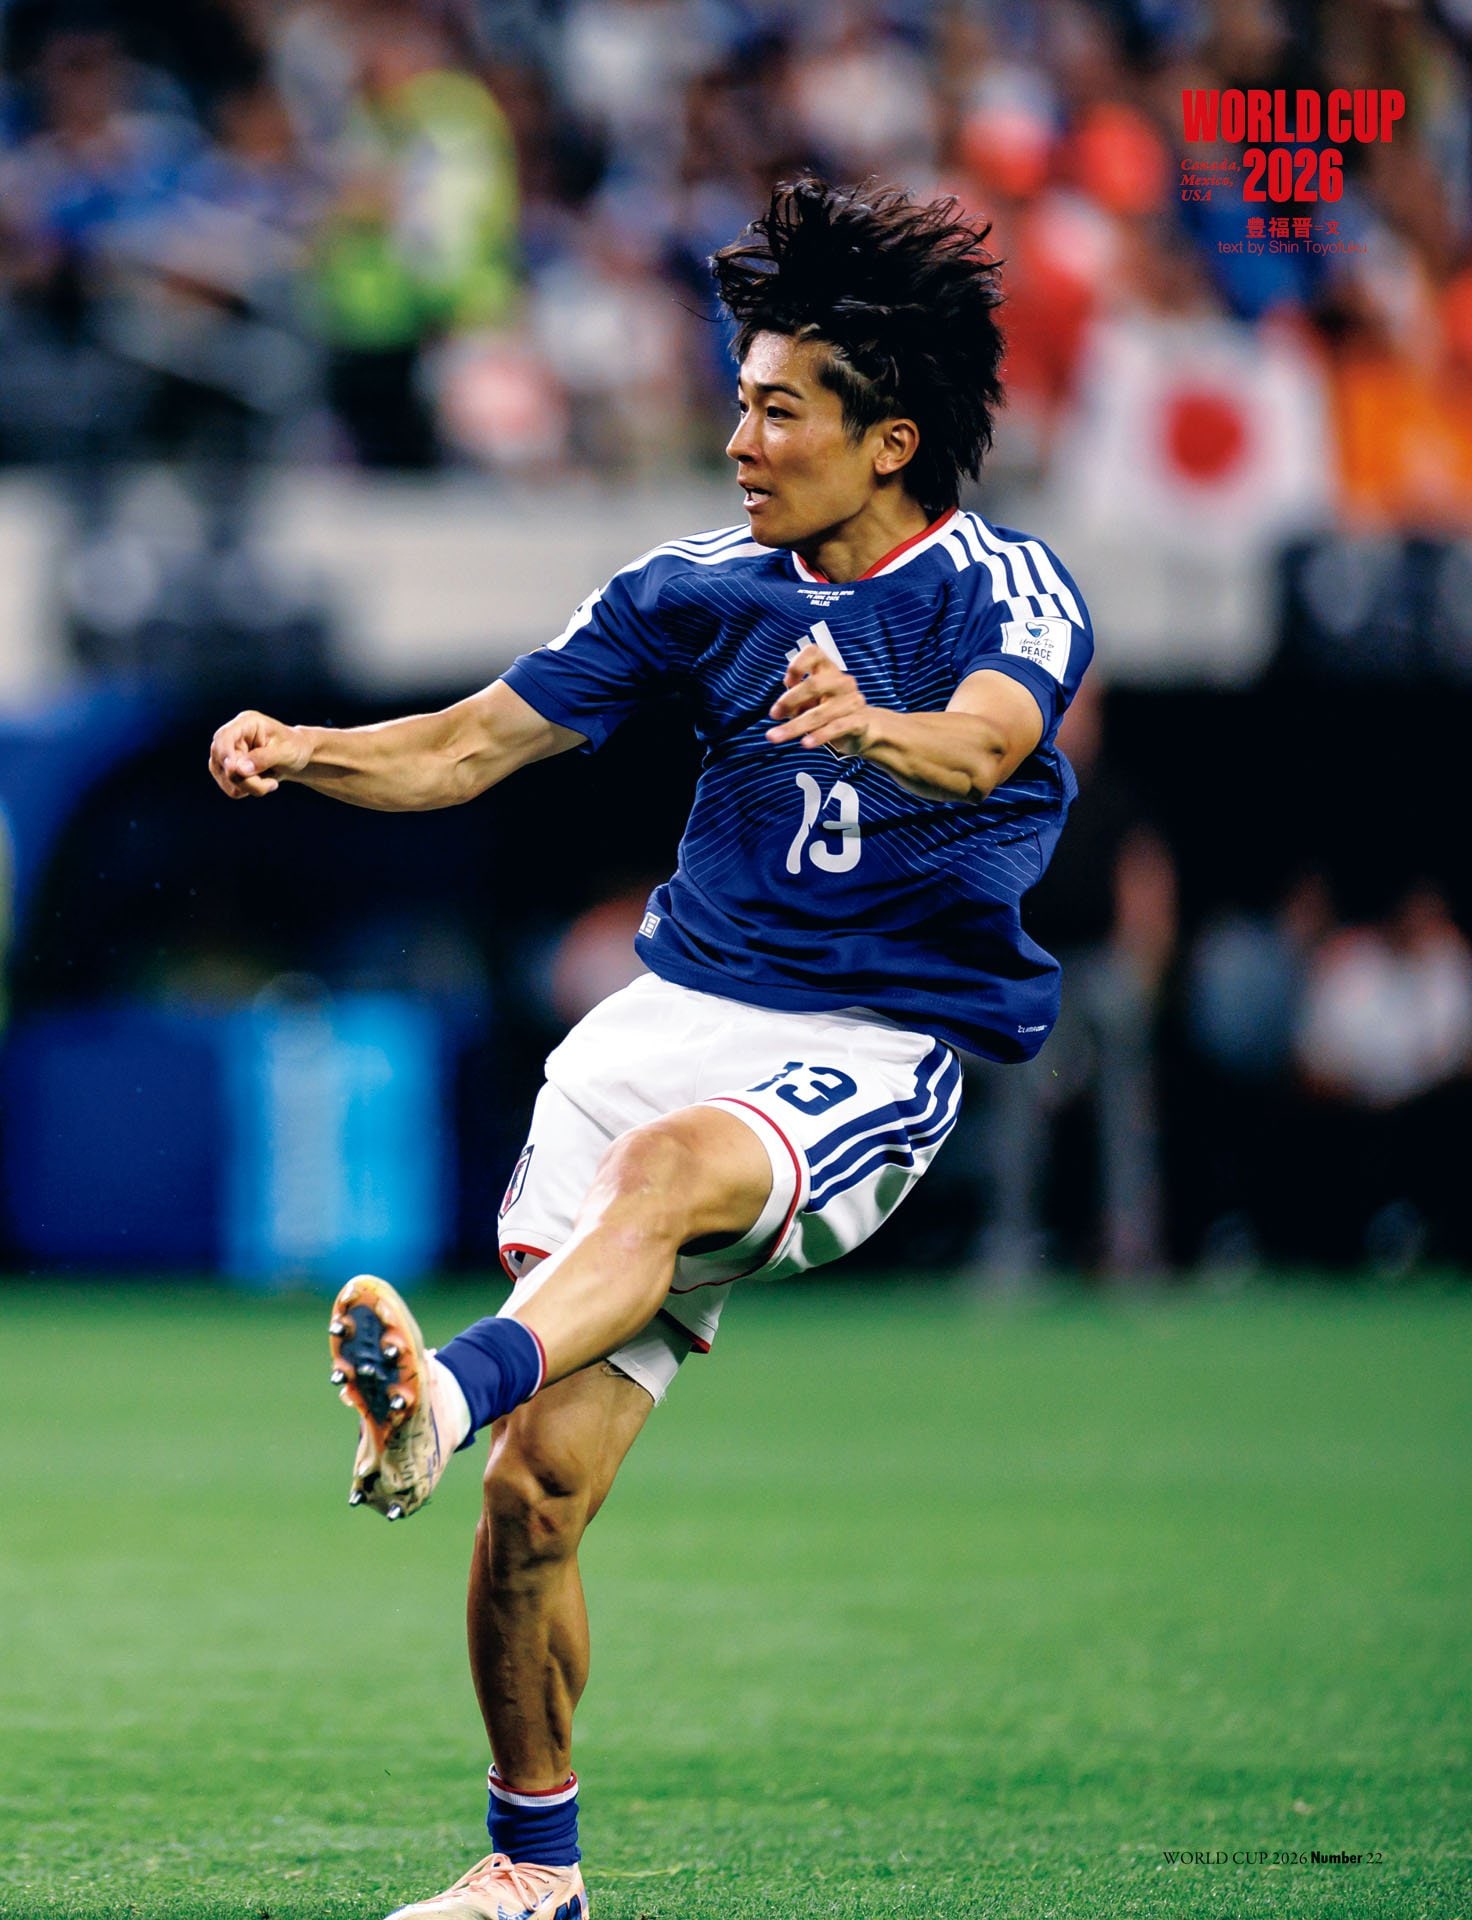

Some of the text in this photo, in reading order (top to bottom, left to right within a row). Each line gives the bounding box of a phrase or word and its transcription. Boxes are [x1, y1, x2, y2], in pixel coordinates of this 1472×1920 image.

[1021, 645, 1052, 661] PEACE
[786, 772, 861, 875] 13
[746, 1061, 857, 1116] 13
